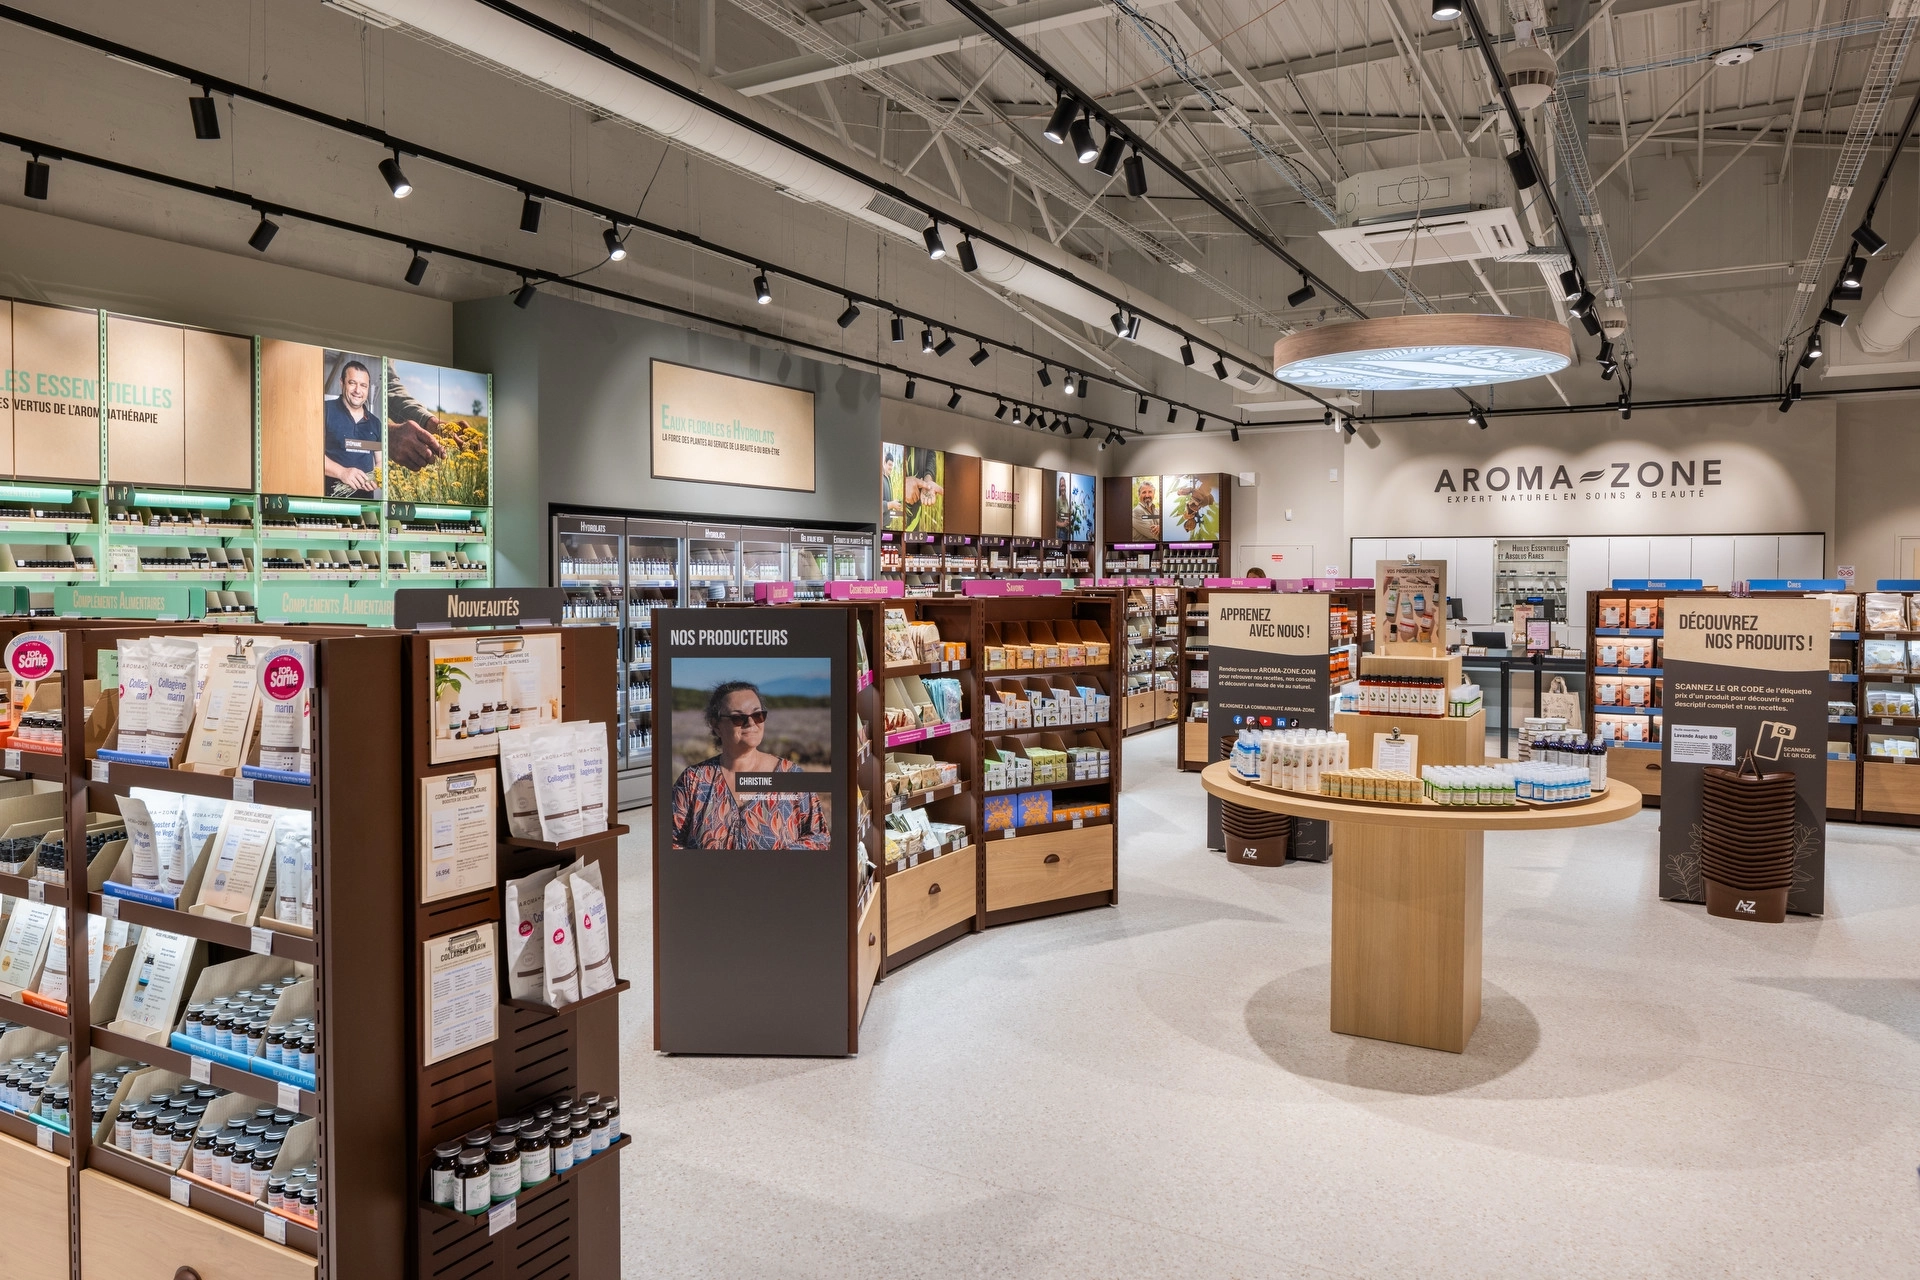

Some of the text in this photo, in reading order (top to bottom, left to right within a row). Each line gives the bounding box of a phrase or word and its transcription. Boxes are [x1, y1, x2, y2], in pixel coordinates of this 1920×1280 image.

[36, 373, 172, 409] ESSENTIELLES
[14, 400, 51, 413] VERTUS
[54, 403, 66, 415] DE
[662, 404, 775, 444] EAUX FLORALES & HYDROLATS
[662, 434, 668, 442] LA
[668, 434, 681, 444] FORCE
[690, 436, 707, 446] PLANTES
[708, 440, 713, 448] AU
[714, 440, 729, 450] SERVICE
[729, 442, 734, 450] DE
[1434, 460, 1722, 492] AROMA ZONE
[109, 486, 128, 500] M P
[1447, 495, 1493, 503] EXPERT
[1502, 493, 1558, 501] NATUREL
[1586, 492, 1626, 500] SOINS
[1652, 489, 1705, 499] BEAUTÉ
[264, 497, 269, 508] P
[278, 497, 283, 509] S
[391, 504, 395, 515] S
[405, 504, 409, 516] Y
[580, 521, 606, 532] HYDROLATS
[850, 583, 888, 594] COSMÉTIQUES SOLIDES
[1006, 582, 1024, 592] SAVONS
[73, 590, 165, 610] COMPLÉMENTS ALIMENTAIRES
[282, 592, 395, 616] COMPLÉMENTS ALIMENTAIR
[448, 594, 519, 618] NOUVEAUTÉS
[1220, 608, 1270, 622] APPRENEZ
[1679, 611, 1758, 631] DÉCOUVREZ
[670, 630, 788, 646] NOS PRODUCTEURS
[1249, 624, 1304, 638] AVEC NOUS
[1706, 633, 1812, 651] NOS PRODUITS !
[18, 654, 48, 668] Santé
[278, 667, 290, 675] TOP
[158, 677, 186, 691] Collagène
[270, 671, 298, 688] Santé
[167, 692, 185, 702] marin
[1705, 693, 1729, 702] produit
[1776, 687, 1812, 695] l'étiquette
[274, 703, 293, 713] marin
[1675, 701, 1706, 709] descriptif
[1707, 702, 1734, 710] complet
[739, 777, 772, 786] CHRISTINE
[273, 1070, 289, 1079] BEAUTÉ
